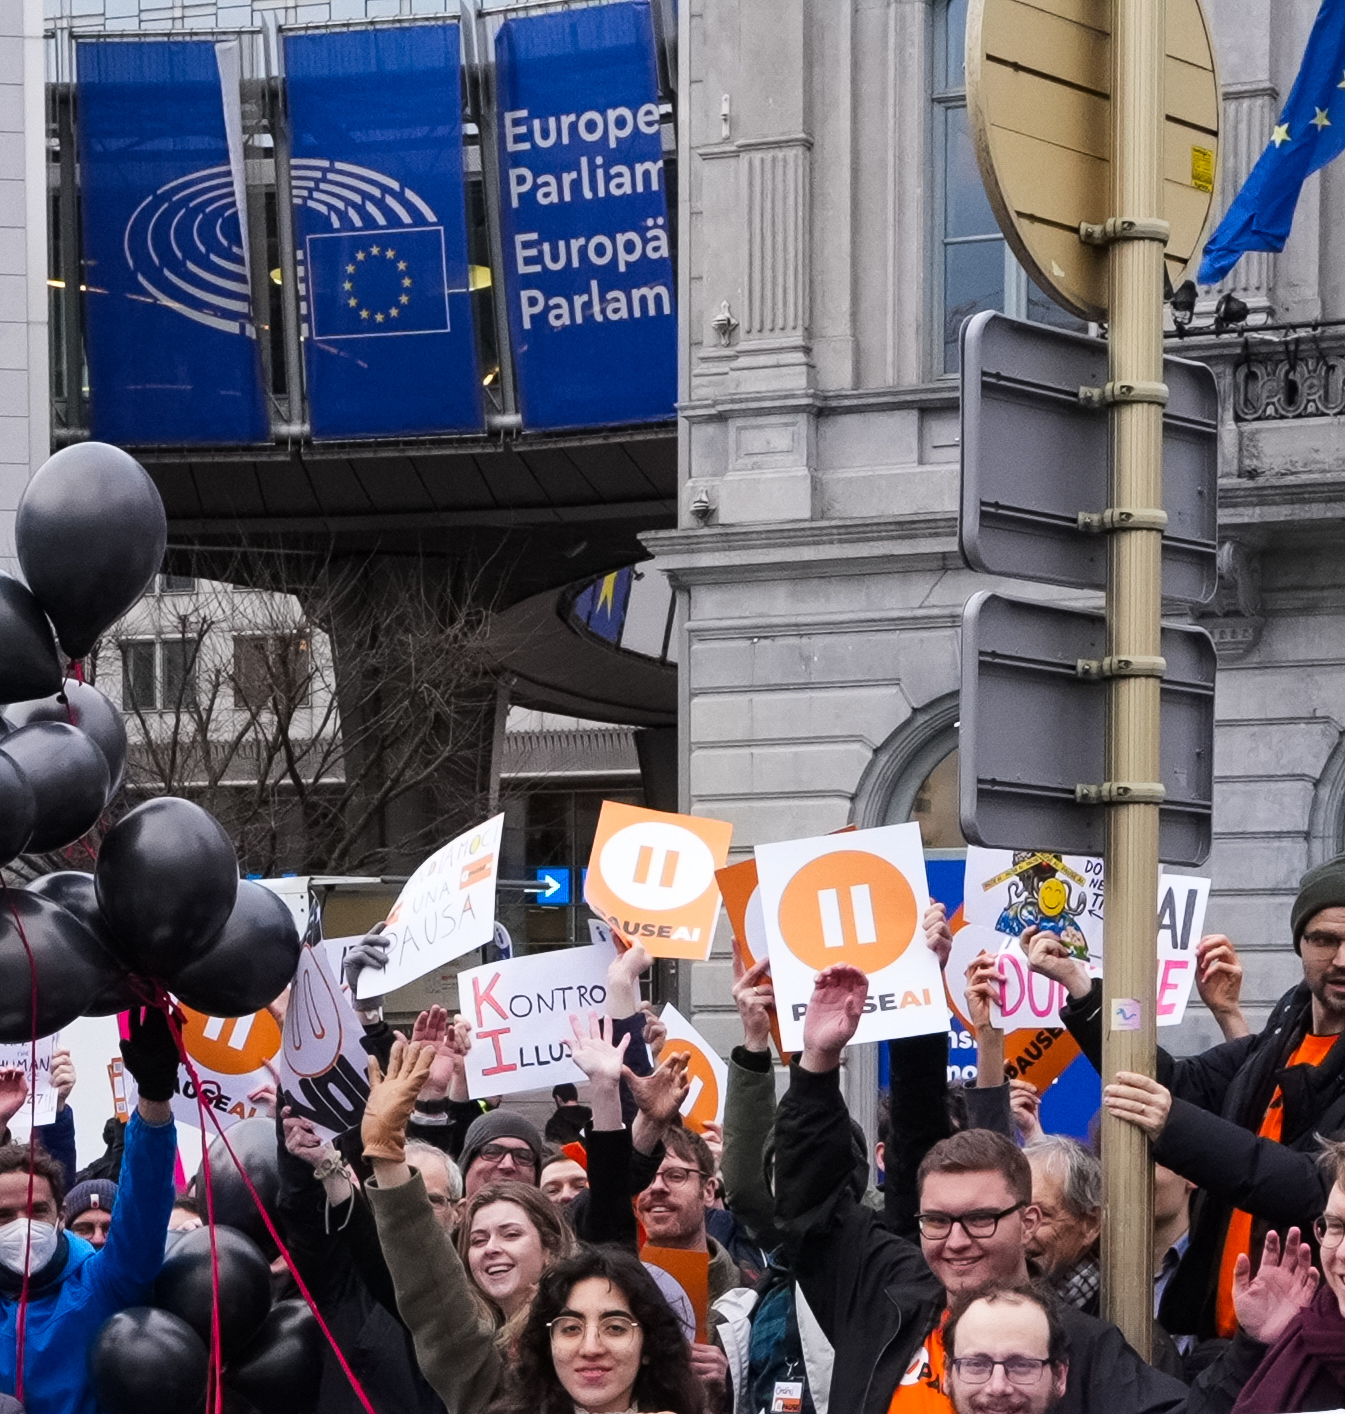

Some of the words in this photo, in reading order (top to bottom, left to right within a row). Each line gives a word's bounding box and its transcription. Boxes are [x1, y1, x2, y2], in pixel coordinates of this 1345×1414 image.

[504, 103, 660, 151] Europe
[509, 156, 664, 208] Parliam
[514, 216, 669, 274] Europä
[520, 279, 671, 329] Parlam
[791, 988, 932, 1022] PSEAI
